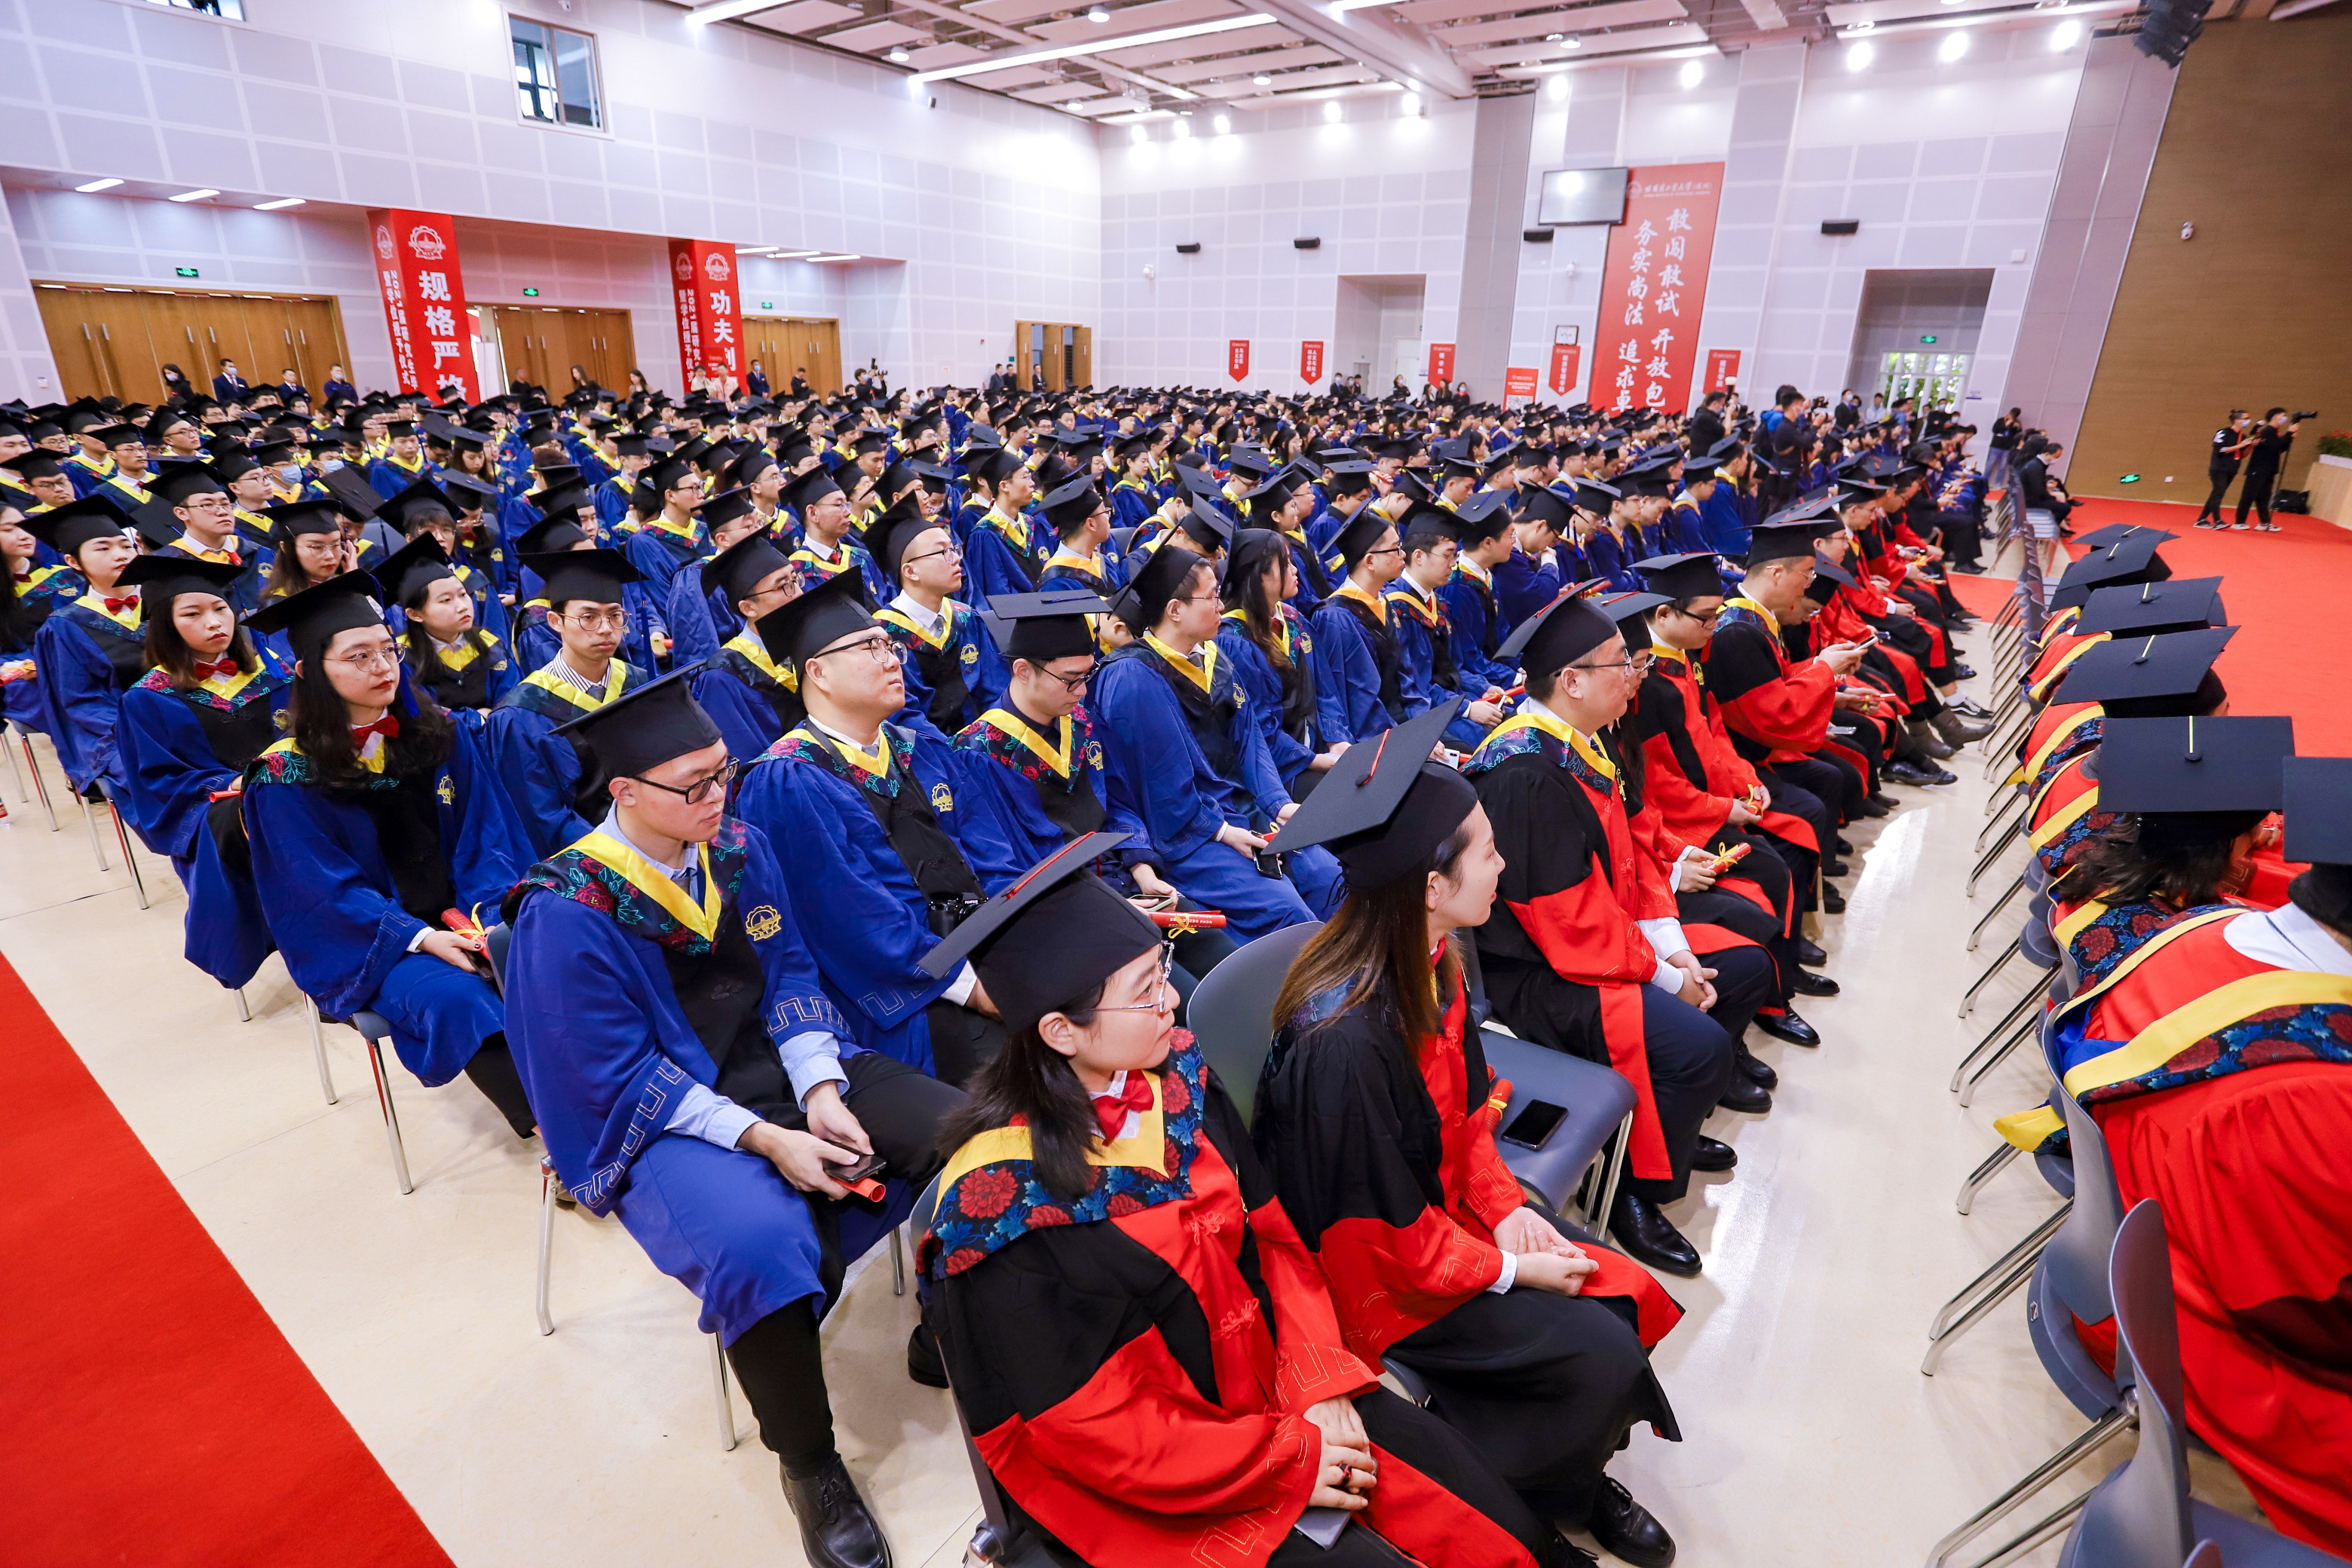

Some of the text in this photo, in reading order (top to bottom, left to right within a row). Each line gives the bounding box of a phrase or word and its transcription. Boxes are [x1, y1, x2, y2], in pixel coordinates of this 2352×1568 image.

[1625, 219, 1658, 326] 务实尚法
[1655, 207, 1693, 317] 敢闯敢试
[687, 289, 701, 366] 2021届研究
[1645, 328, 1675, 415] 开放包
